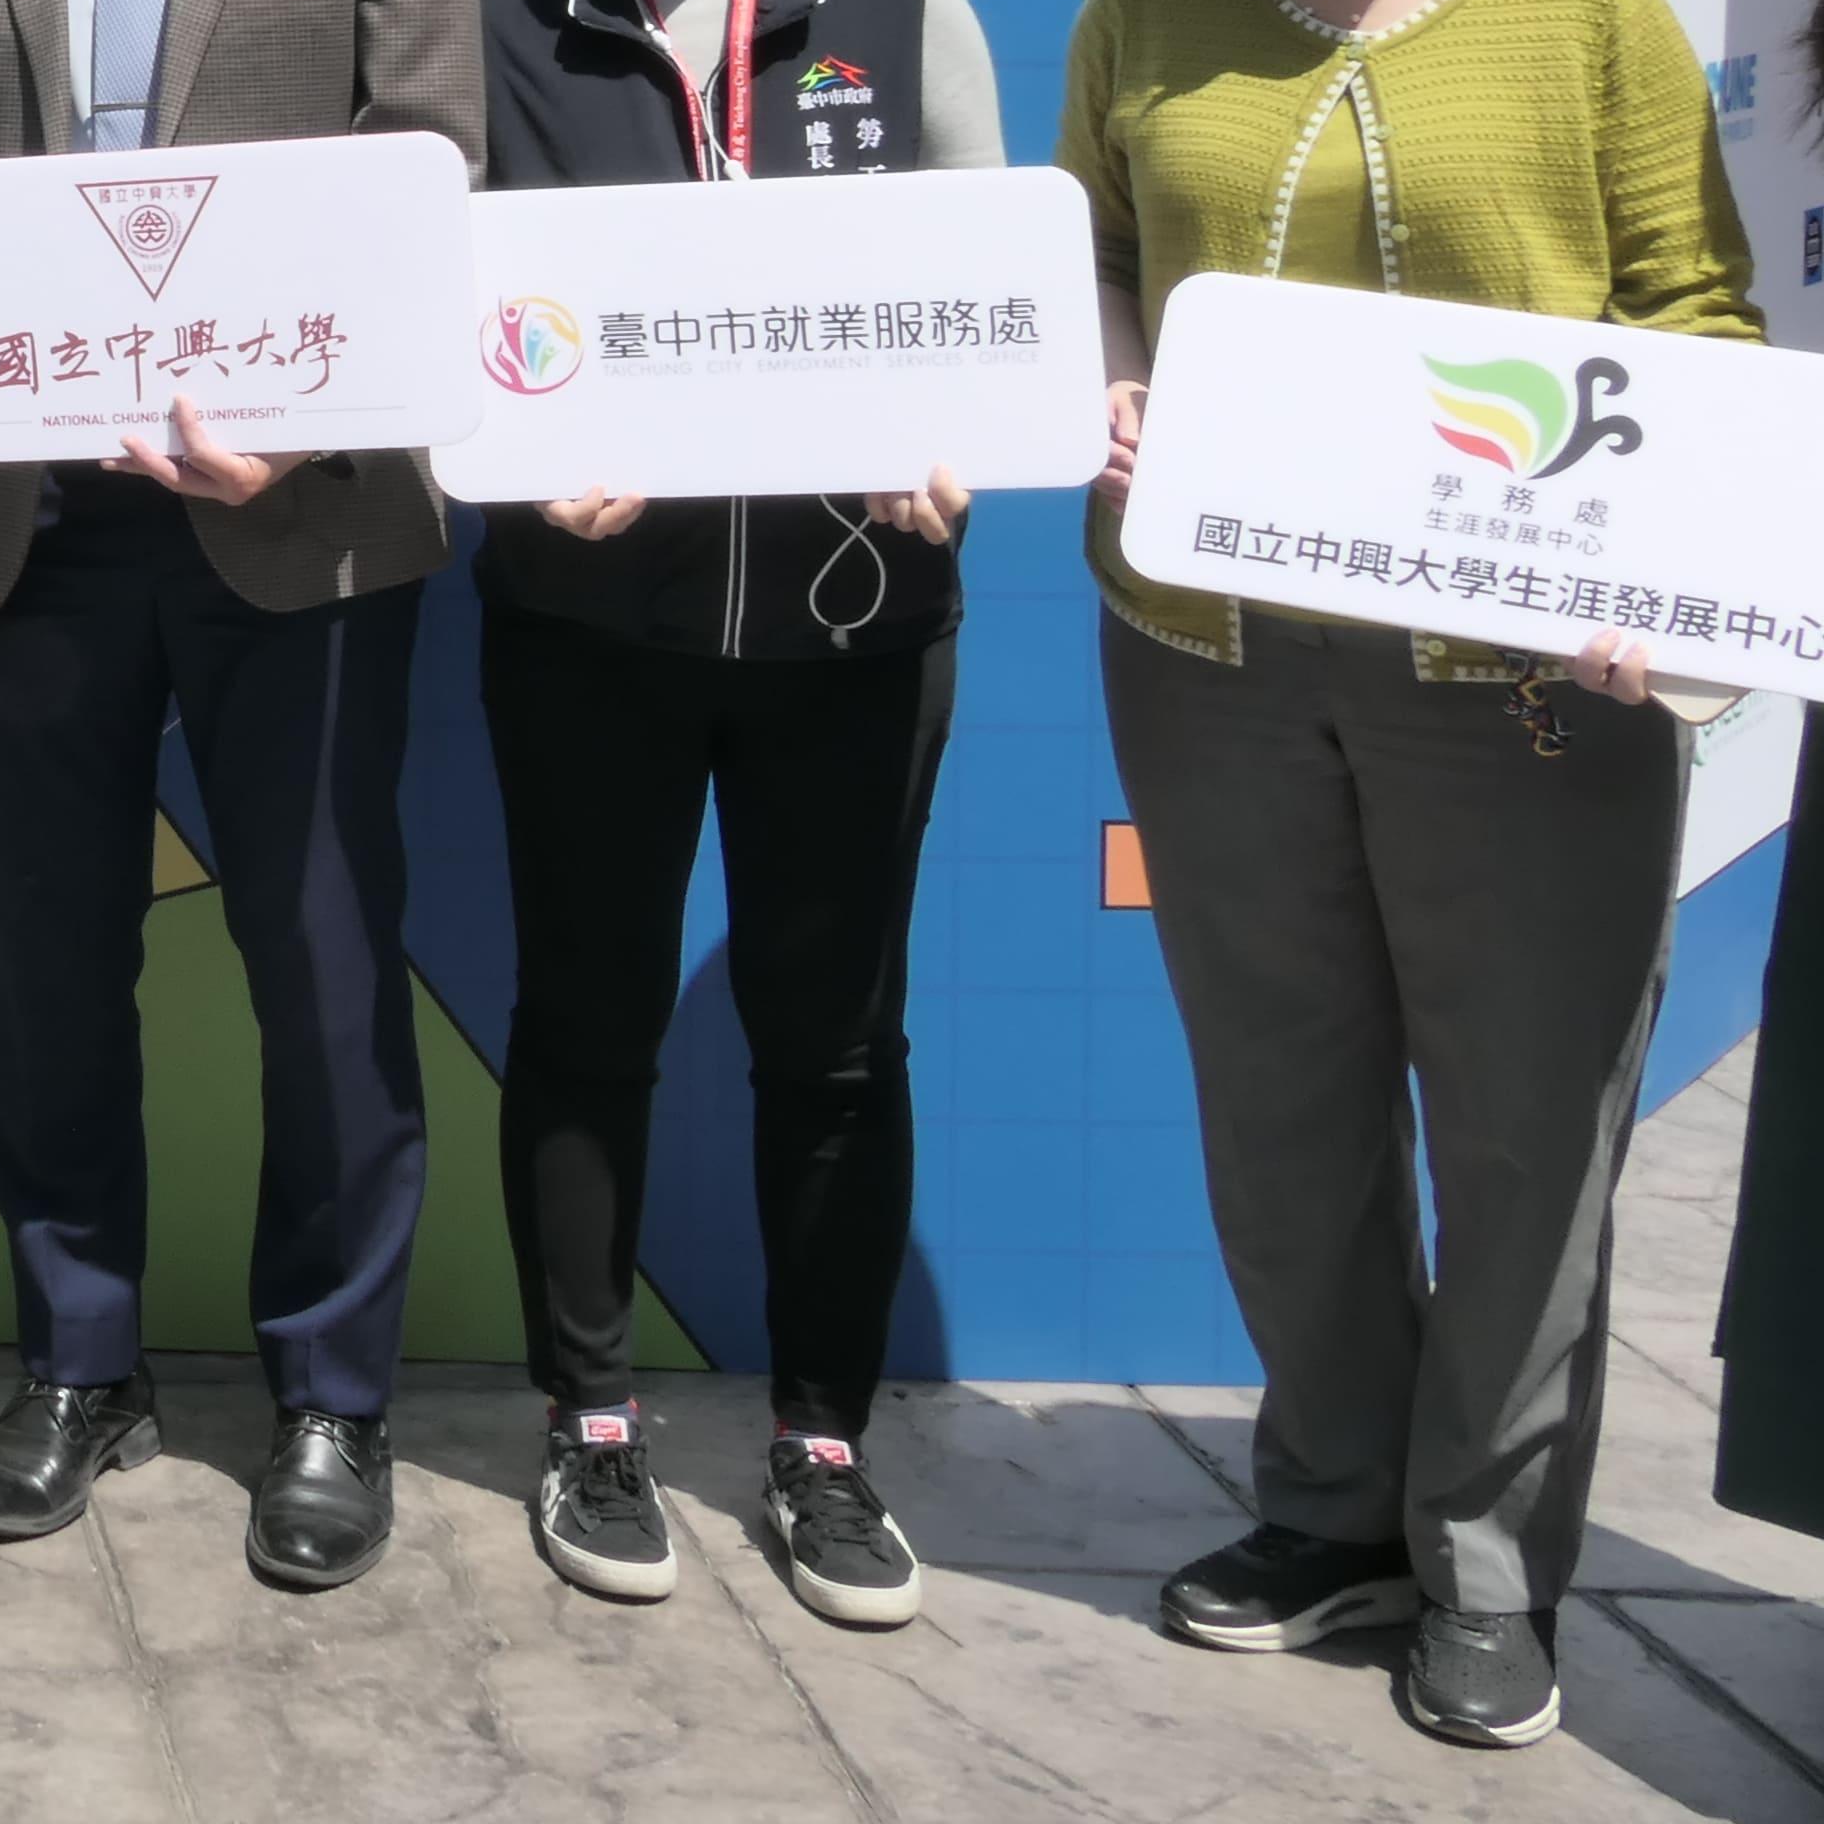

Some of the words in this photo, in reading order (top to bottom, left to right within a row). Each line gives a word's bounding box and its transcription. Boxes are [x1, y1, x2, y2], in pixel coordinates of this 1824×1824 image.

[598, 297, 1041, 360] 臺中市就業服務處
[602, 360, 693, 377] TAICHUNG
[706, 359, 743, 375] CITY
[757, 354, 871, 372] EMPLOYMENT
[887, 351, 964, 368] SERVICES
[977, 349, 1040, 366] OFFICE
[42, 415, 107, 427] NATIONAL
[112, 412, 159, 425] CHUNG
[207, 406, 287, 422] UNIVERSITY
[1423, 507, 1604, 557] 生涯發展中心
[1193, 513, 1824, 662] 國立中興大學生涯發展中心
